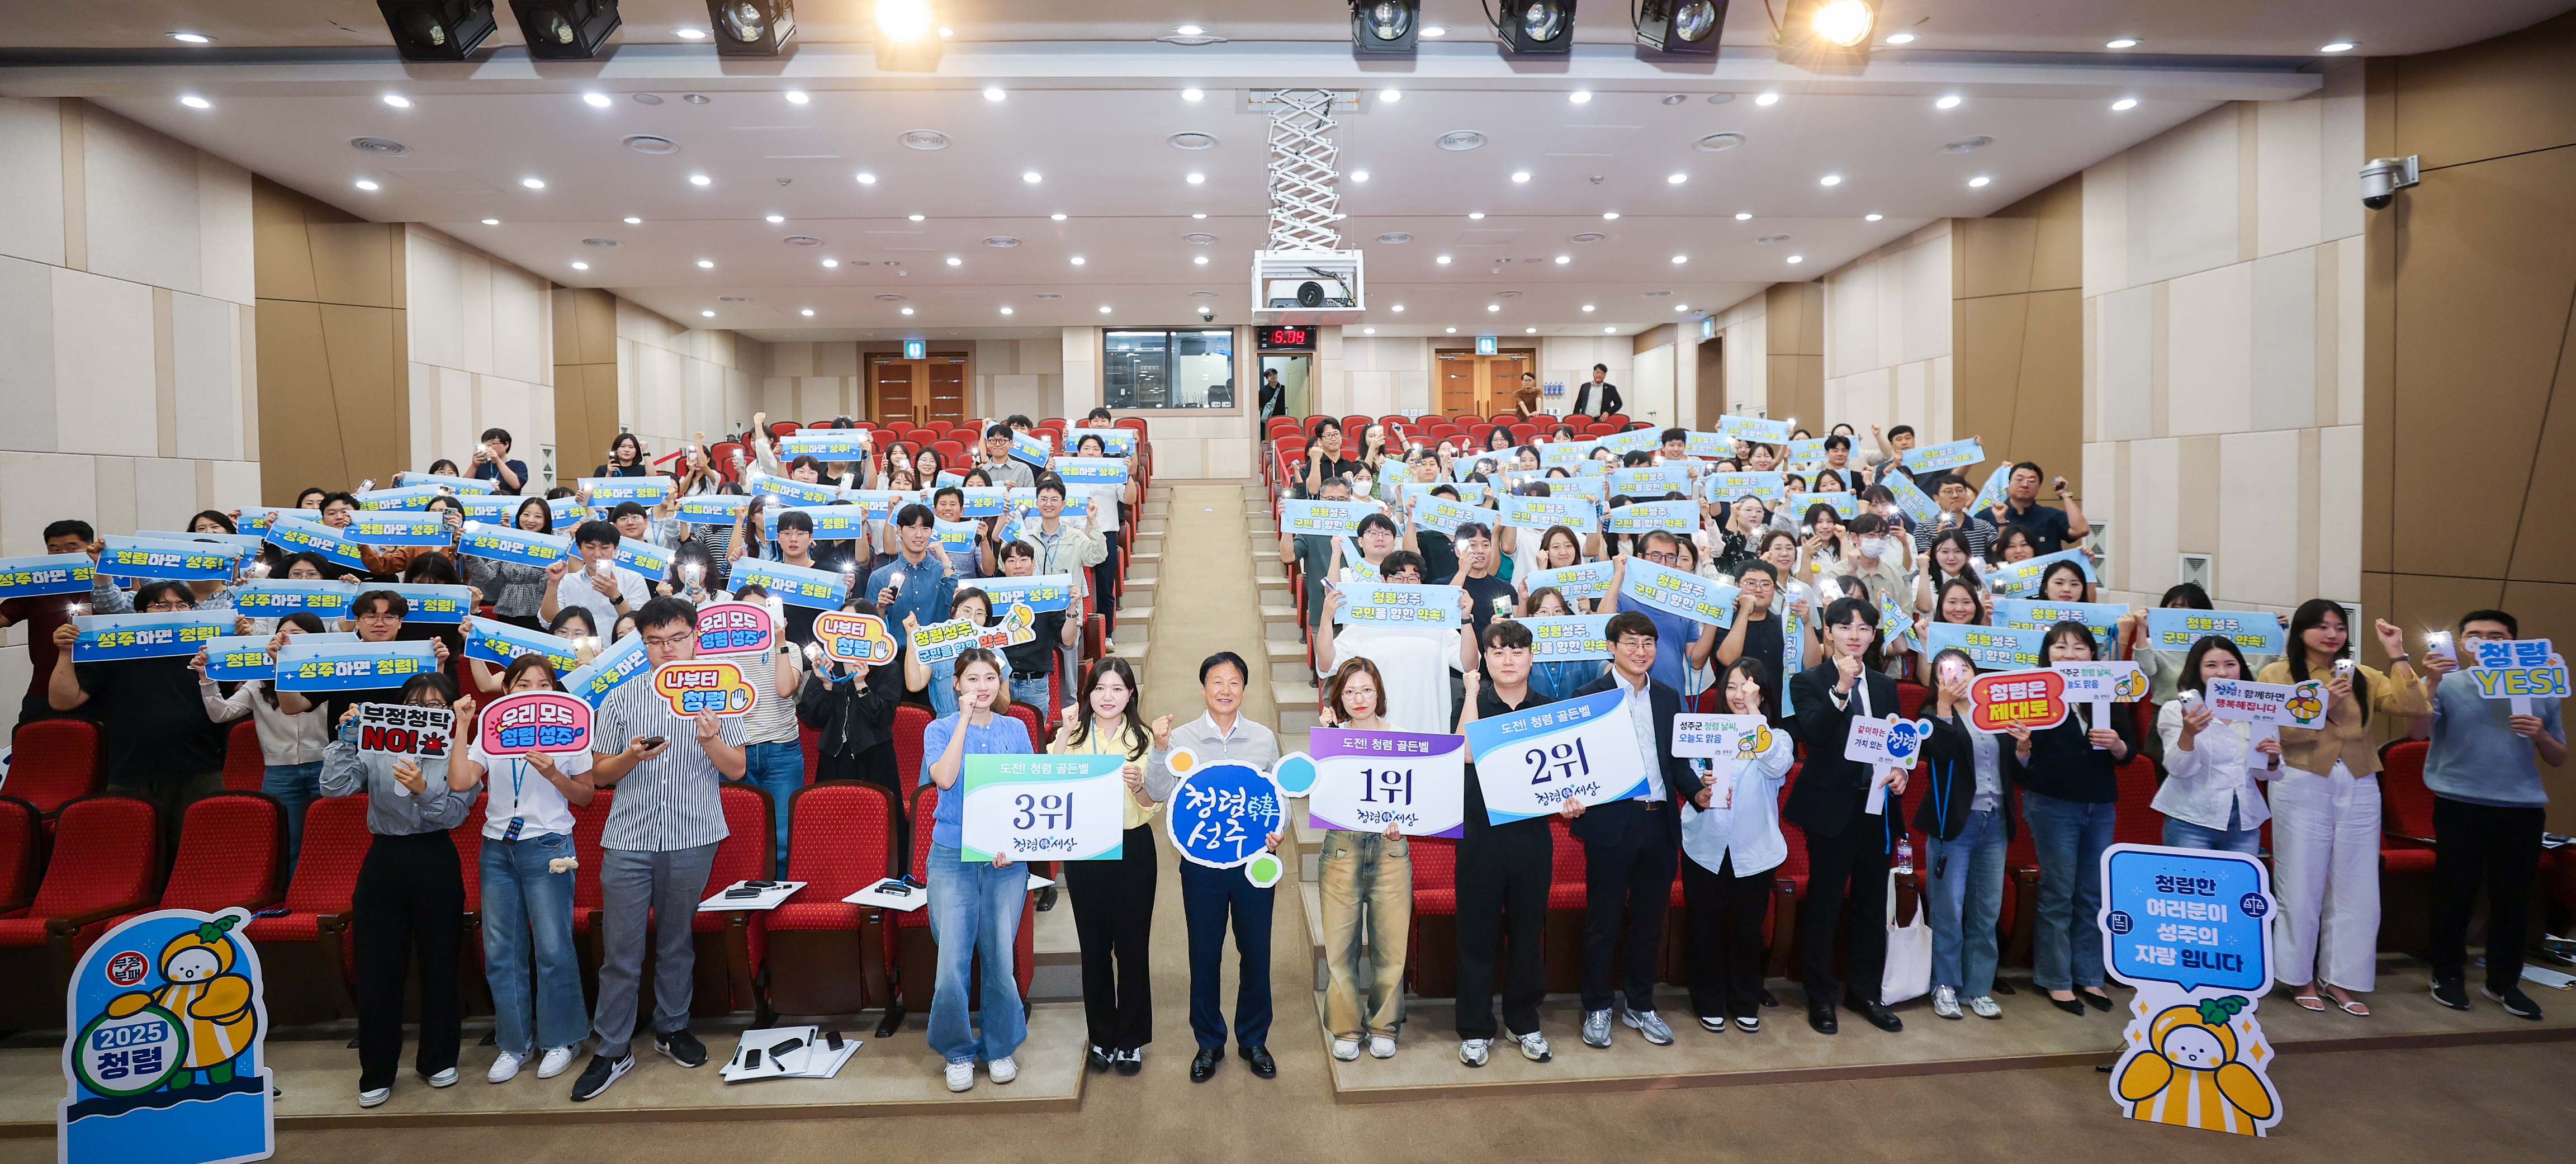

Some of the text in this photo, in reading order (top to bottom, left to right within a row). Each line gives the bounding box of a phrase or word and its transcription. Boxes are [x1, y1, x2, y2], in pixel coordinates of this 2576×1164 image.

[1740, 420, 1769, 431] 청렴성주,
[1618, 434, 1646, 444] 청렴성주,
[1690, 436, 1717, 444] 청렴성주,
[1728, 428, 1779, 441] 군민을 향한 약속!
[790, 443, 850, 453] 청렴하면 성주!
[1107, 438, 1126, 447] 성주!
[1559, 446, 1587, 454] 청렴성주,
[1022, 444, 1041, 458] 청렴!
[1797, 451, 1817, 459] 군민을
[1923, 447, 1957, 459] 청렴성주,
[1912, 453, 1972, 470] 군민을 향한 약속!
[1062, 466, 1120, 476] 청렴하면 성주!
[1633, 473, 1666, 481] 청렴성주,
[1620, 482, 1680, 492] 군민을 향한 약속!
[1727, 477, 1759, 486] 청렴성주,
[593, 487, 660, 499] 성주하면 청렴!
[761, 480, 827, 505] 청렴하면 성주!
[1715, 488, 1773, 496] 군민을 약속!
[405, 495, 432, 508] 성주!
[682, 503, 722, 515] 청렴하면
[973, 497, 996, 508] 성주!
[1527, 503, 1567, 515] 청렴성주,
[1310, 506, 1351, 519] 청렴성주,
[1422, 512, 1447, 526] 군민을
[1437, 504, 1475, 522] 청렴성주,
[1512, 512, 1583, 527] 군민을 향한 약속!
[1630, 507, 1670, 517] 청렴성주,
[359, 523, 439, 536] 청렴하면 성주!
[822, 518, 849, 529] 청렴!
[1294, 519, 1343, 530] 군민을 향한
[1614, 517, 1686, 528] 군민을 향한 약속!
[283, 530, 335, 551] 성주하면
[940, 533, 966, 543] 청렴!
[473, 536, 557, 559] 성주하면 청렴!
[117, 551, 224, 570] 청렴하면 성주!
[633, 554, 663, 571] 청렴!
[1556, 569, 1599, 583] 청렴성주,
[745, 572, 831, 599] 성주하면 청렴!
[1573, 583, 1592, 594] 향한
[1657, 573, 1707, 600] 청렴성주,
[239, 593, 341, 607] 성주하면 청렴!
[1029, 588, 1059, 602] 성주!
[1373, 592, 1424, 606] 청렴성주,
[1635, 581, 1725, 620] 군민을 향한 약속!
[424, 599, 455, 612] 청렴!
[1351, 606, 1445, 621] 군민을 향한 약속!
[2032, 608, 2088, 623] 청렴성주,
[699, 611, 758, 633] 우리 모두
[824, 619, 866, 637] 나부터
[2187, 617, 2243, 632] 청렴성주,
[97, 626, 220, 647] 성주하면 청렴!
[913, 621, 978, 646] 청렴성주,
[1537, 623, 1590, 638] 청렴성주,
[700, 630, 759, 649] 청렴 성주
[836, 637, 872, 657] 청렴
[919, 632, 1008, 662] 군민을 약속
[1556, 640, 1580, 654] 향한
[1966, 633, 2021, 649] 청렴성주,
[2236, 633, 2266, 648] 약속!
[1986, 649, 2011, 663] 향한
[2479, 642, 2548, 668] 청렴
[299, 658, 418, 678] 성주하면 청렴!
[590, 649, 647, 694] 성주하면
[664, 670, 719, 689] 나부터
[2083, 680, 2099, 689] 맑음
[2473, 668, 2566, 695] YES!
[1988, 680, 2047, 702] 청렴은
[2244, 689, 2285, 702] 함께하면
[683, 690, 727, 712] 청렴
[363, 706, 451, 730] 부정청탁
[501, 703, 574, 728] 우리 모두
[1989, 700, 2049, 721] 제대로
[1502, 704, 1592, 735] 도전! 청렴 골든벨
[1680, 721, 1739, 732] 성주군 청렴 날씨,
[501, 725, 574, 747] 청렴 성주
[1678, 733, 1722, 744] 오늘도 맑음
[1739, 729, 1754, 737] Good!
[1858, 725, 1886, 737] 같이하는
[362, 726, 419, 754] NO!
[1343, 738, 1429, 753] 도전! 청렴 골든벨
[1854, 738, 1883, 750] 가치 있는
[1888, 730, 1917, 751] 청렴
[1000, 762, 1089, 774] 도전! 청렴 골든벨
[1526, 737, 1589, 785] 2위
[1360, 769, 1412, 805] 1위
[1014, 792, 1073, 830] 3위
[1187, 818, 1248, 859] 성주
[2155, 874, 2217, 897] 청렴한
[2146, 898, 2228, 923] 여러분이
[2157, 923, 2219, 947] 성주의
[115, 956, 141, 969] 부정
[2135, 944, 2244, 973] 자랑 입니다
[115, 969, 141, 982] 부패
[100, 1025, 162, 1048] 2025
[97, 1046, 163, 1080] 청렴
